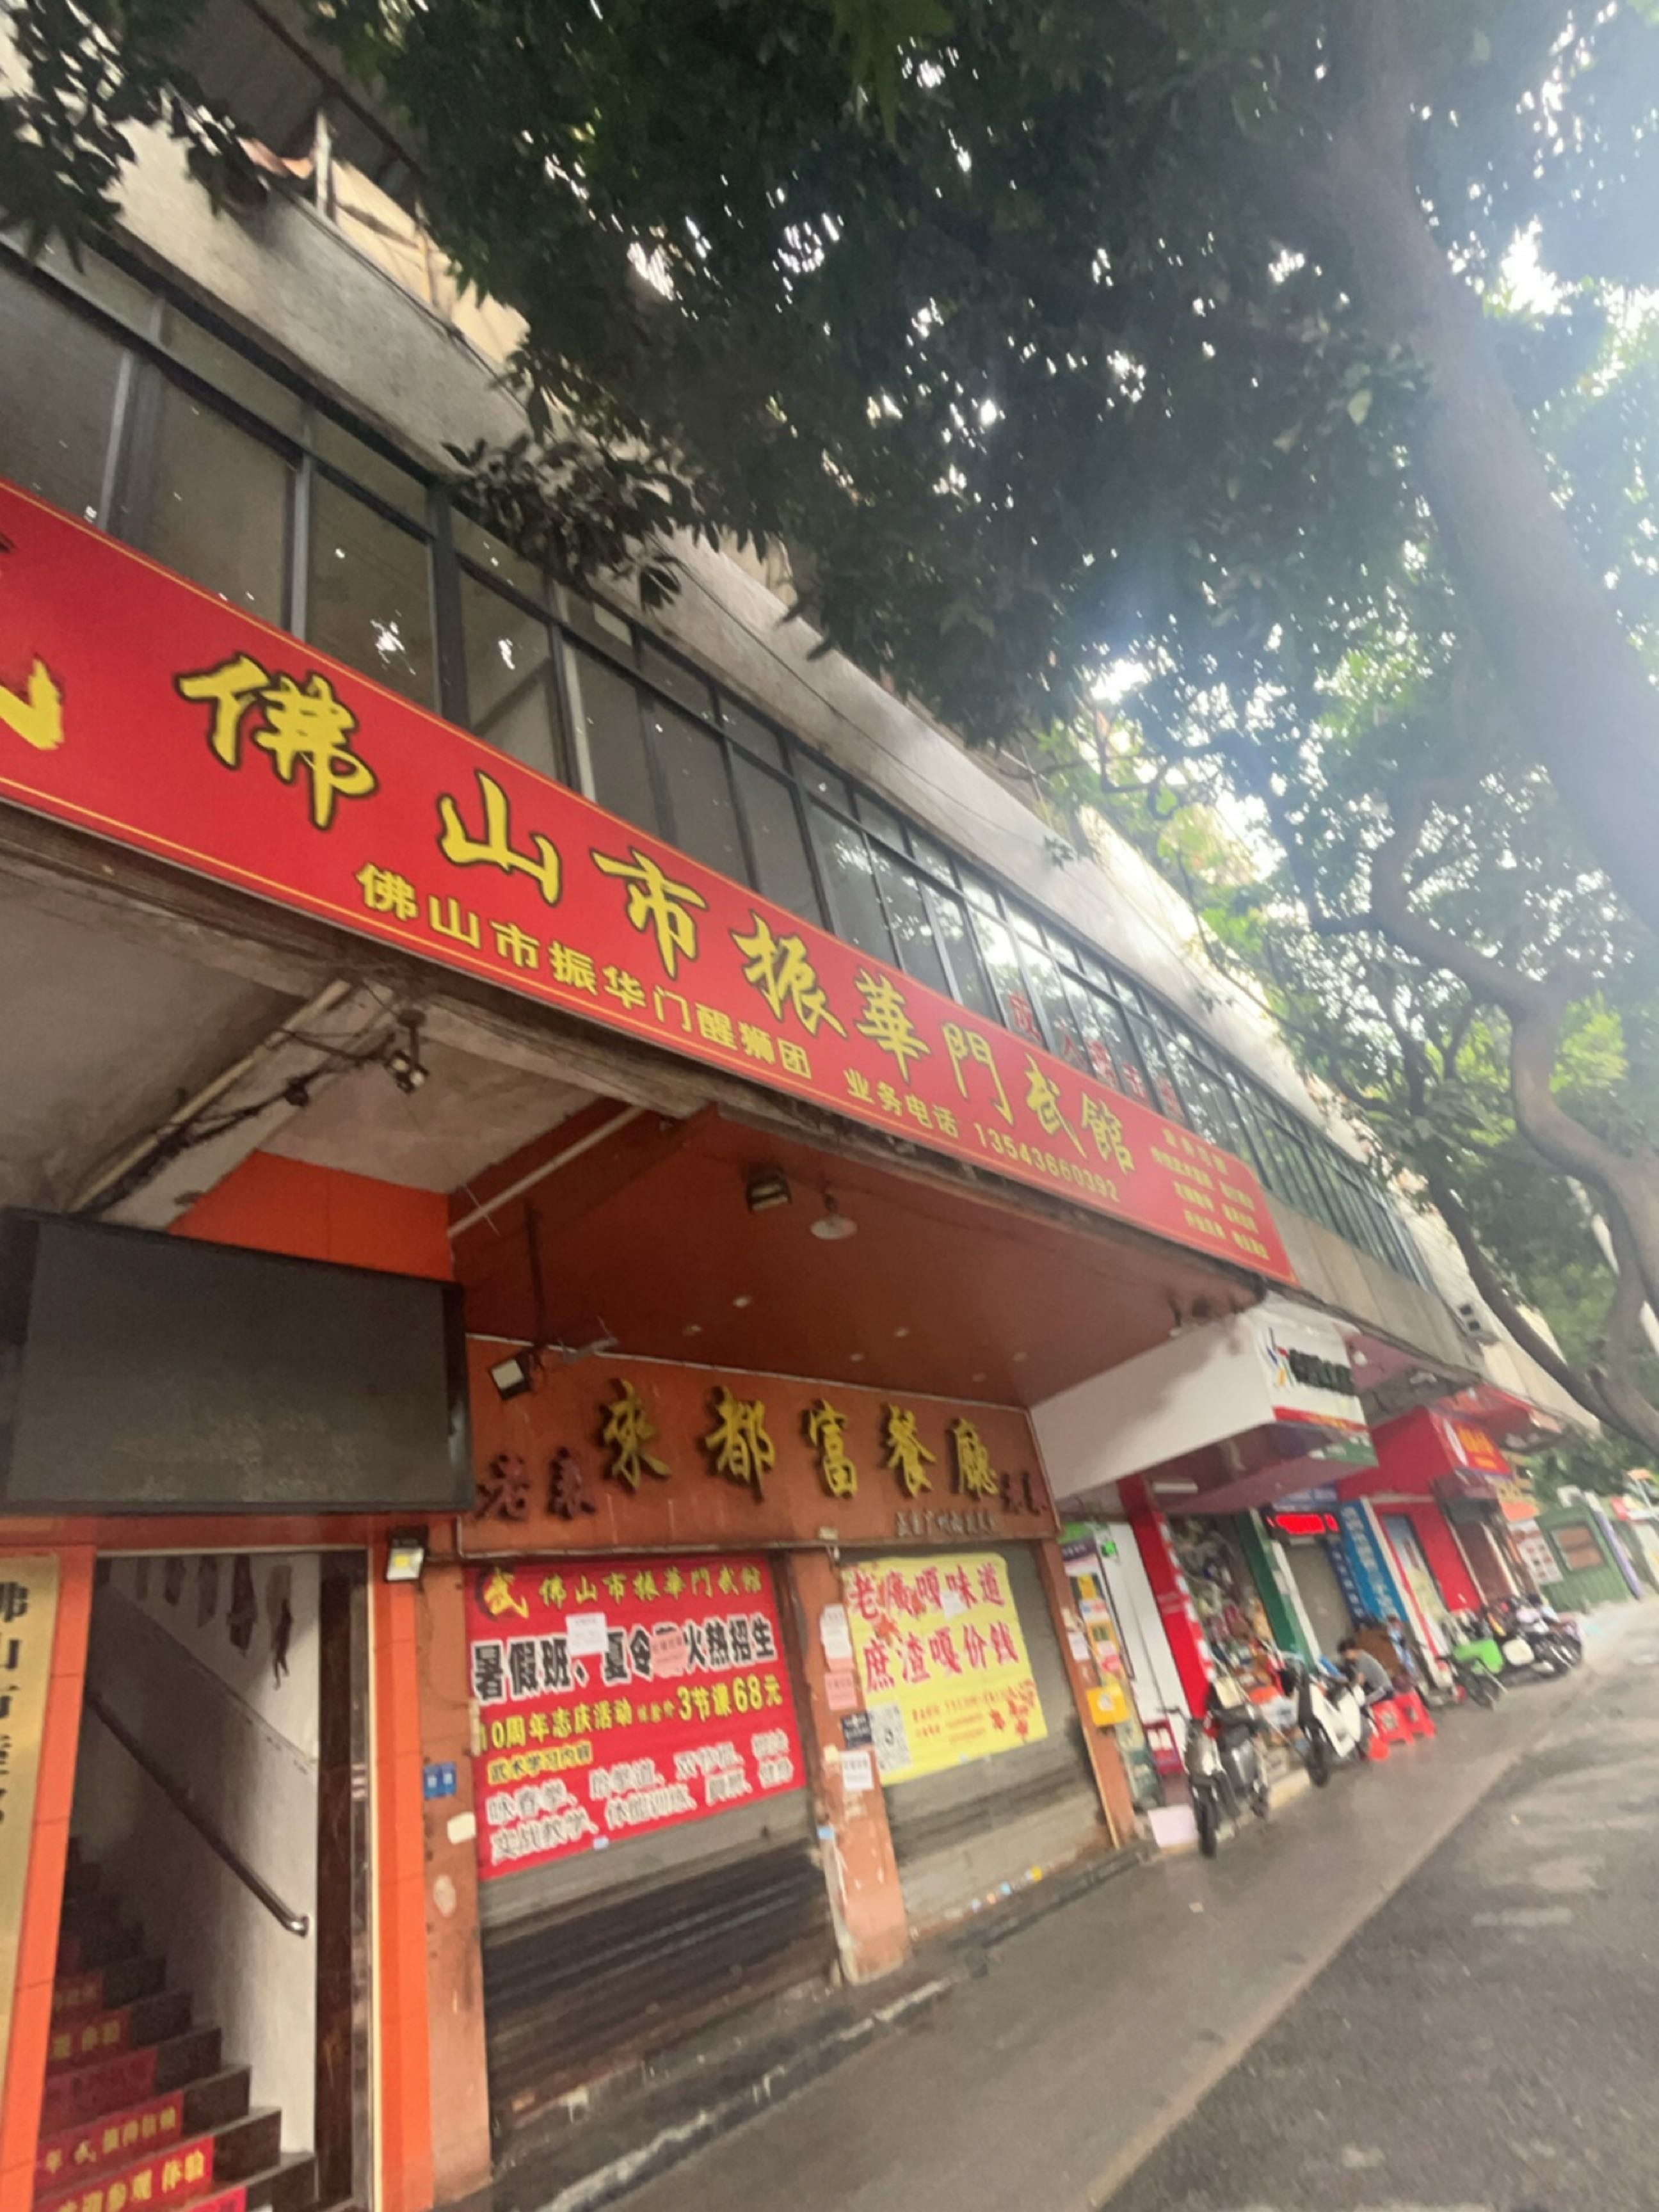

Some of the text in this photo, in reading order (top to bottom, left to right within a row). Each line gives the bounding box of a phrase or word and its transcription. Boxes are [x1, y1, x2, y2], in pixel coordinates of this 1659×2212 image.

[357, 862, 812, 1080] 佛山市振华门醒狮团
[843, 1068, 958, 1138] 业务电话
[473, 1612, 776, 1705] 暑假班、夏令火热招生
